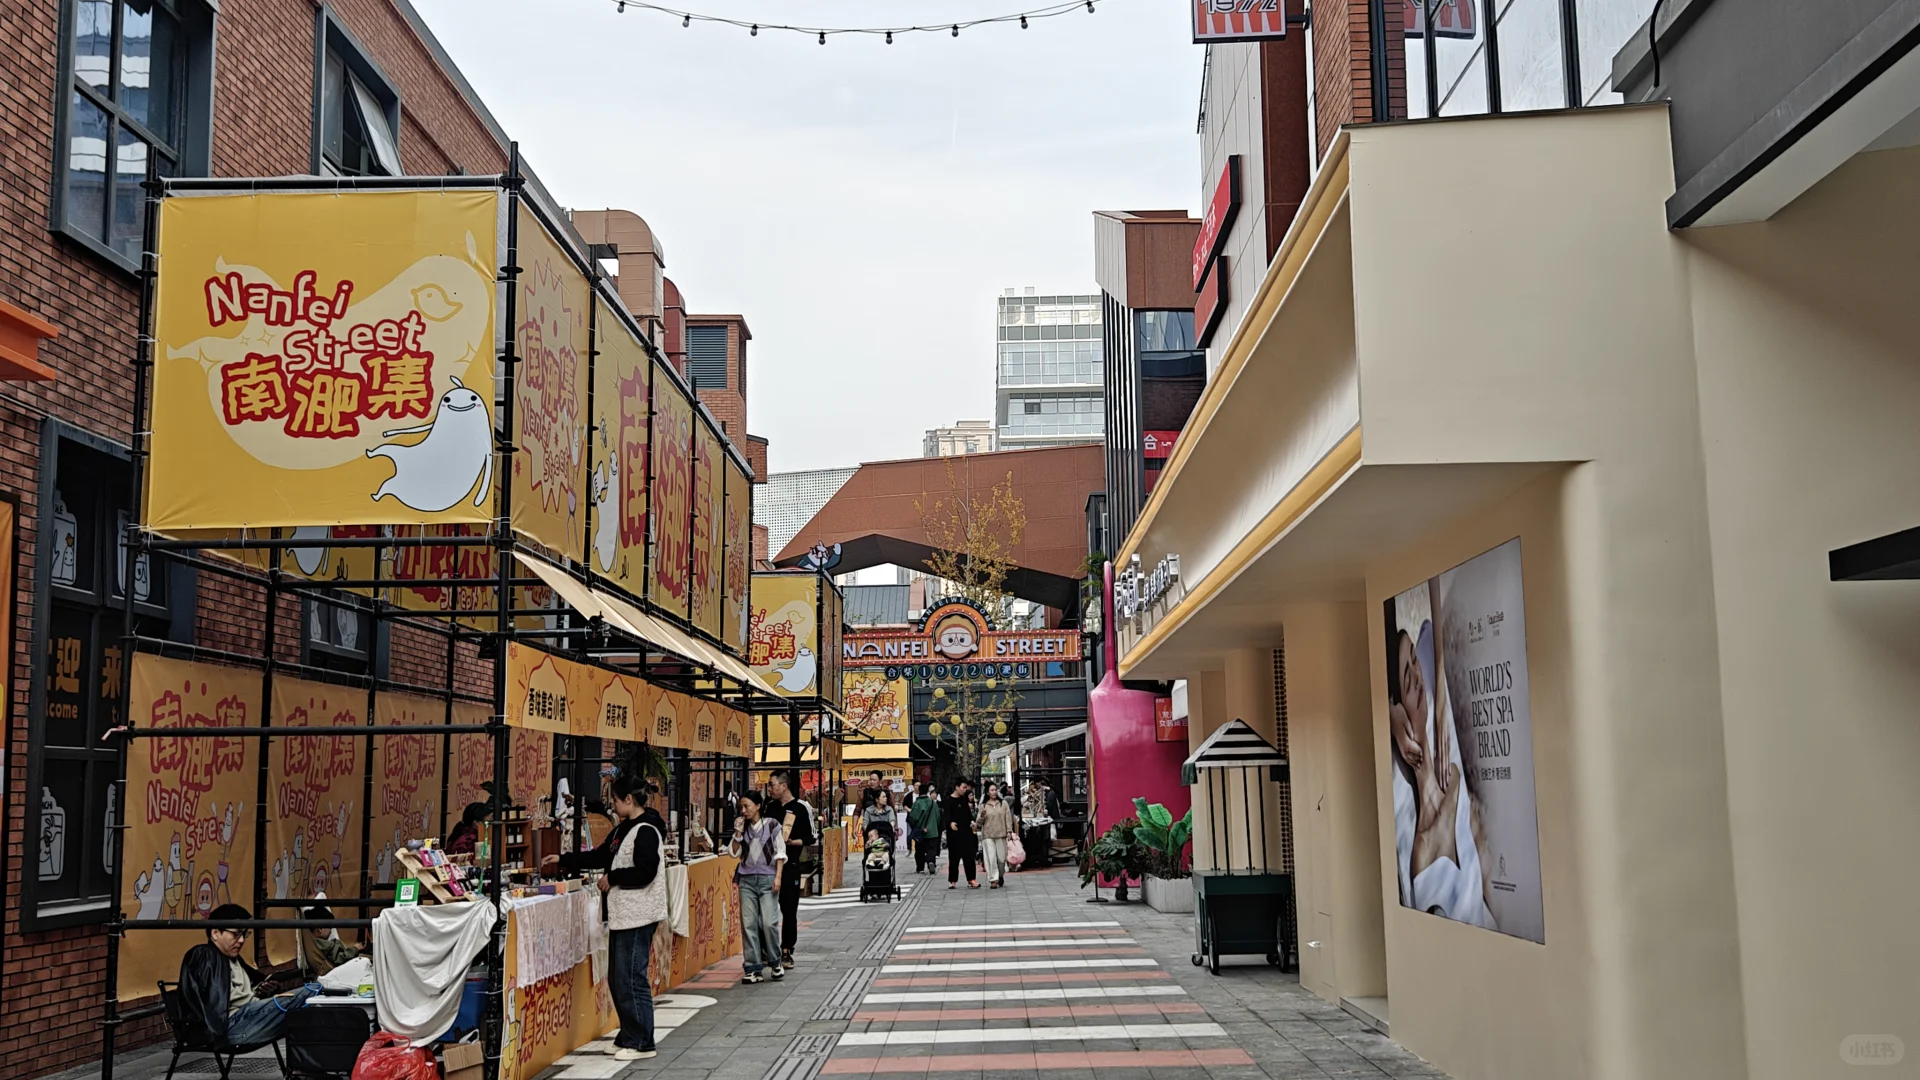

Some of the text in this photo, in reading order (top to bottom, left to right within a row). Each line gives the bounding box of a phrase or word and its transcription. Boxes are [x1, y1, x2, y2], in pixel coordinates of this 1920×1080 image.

[206, 271, 352, 326] Nanfei
[284, 311, 425, 372] Street
[843, 638, 1066, 658] NANFEI STREET
[1469, 660, 1512, 696] WORLD'S
[1472, 694, 1514, 728] BEST SPA
[1478, 728, 1511, 758] BRAND
[147, 779, 201, 824] Nanfei
[279, 781, 320, 819] Nanfei
[536, 986, 572, 1047] Street
